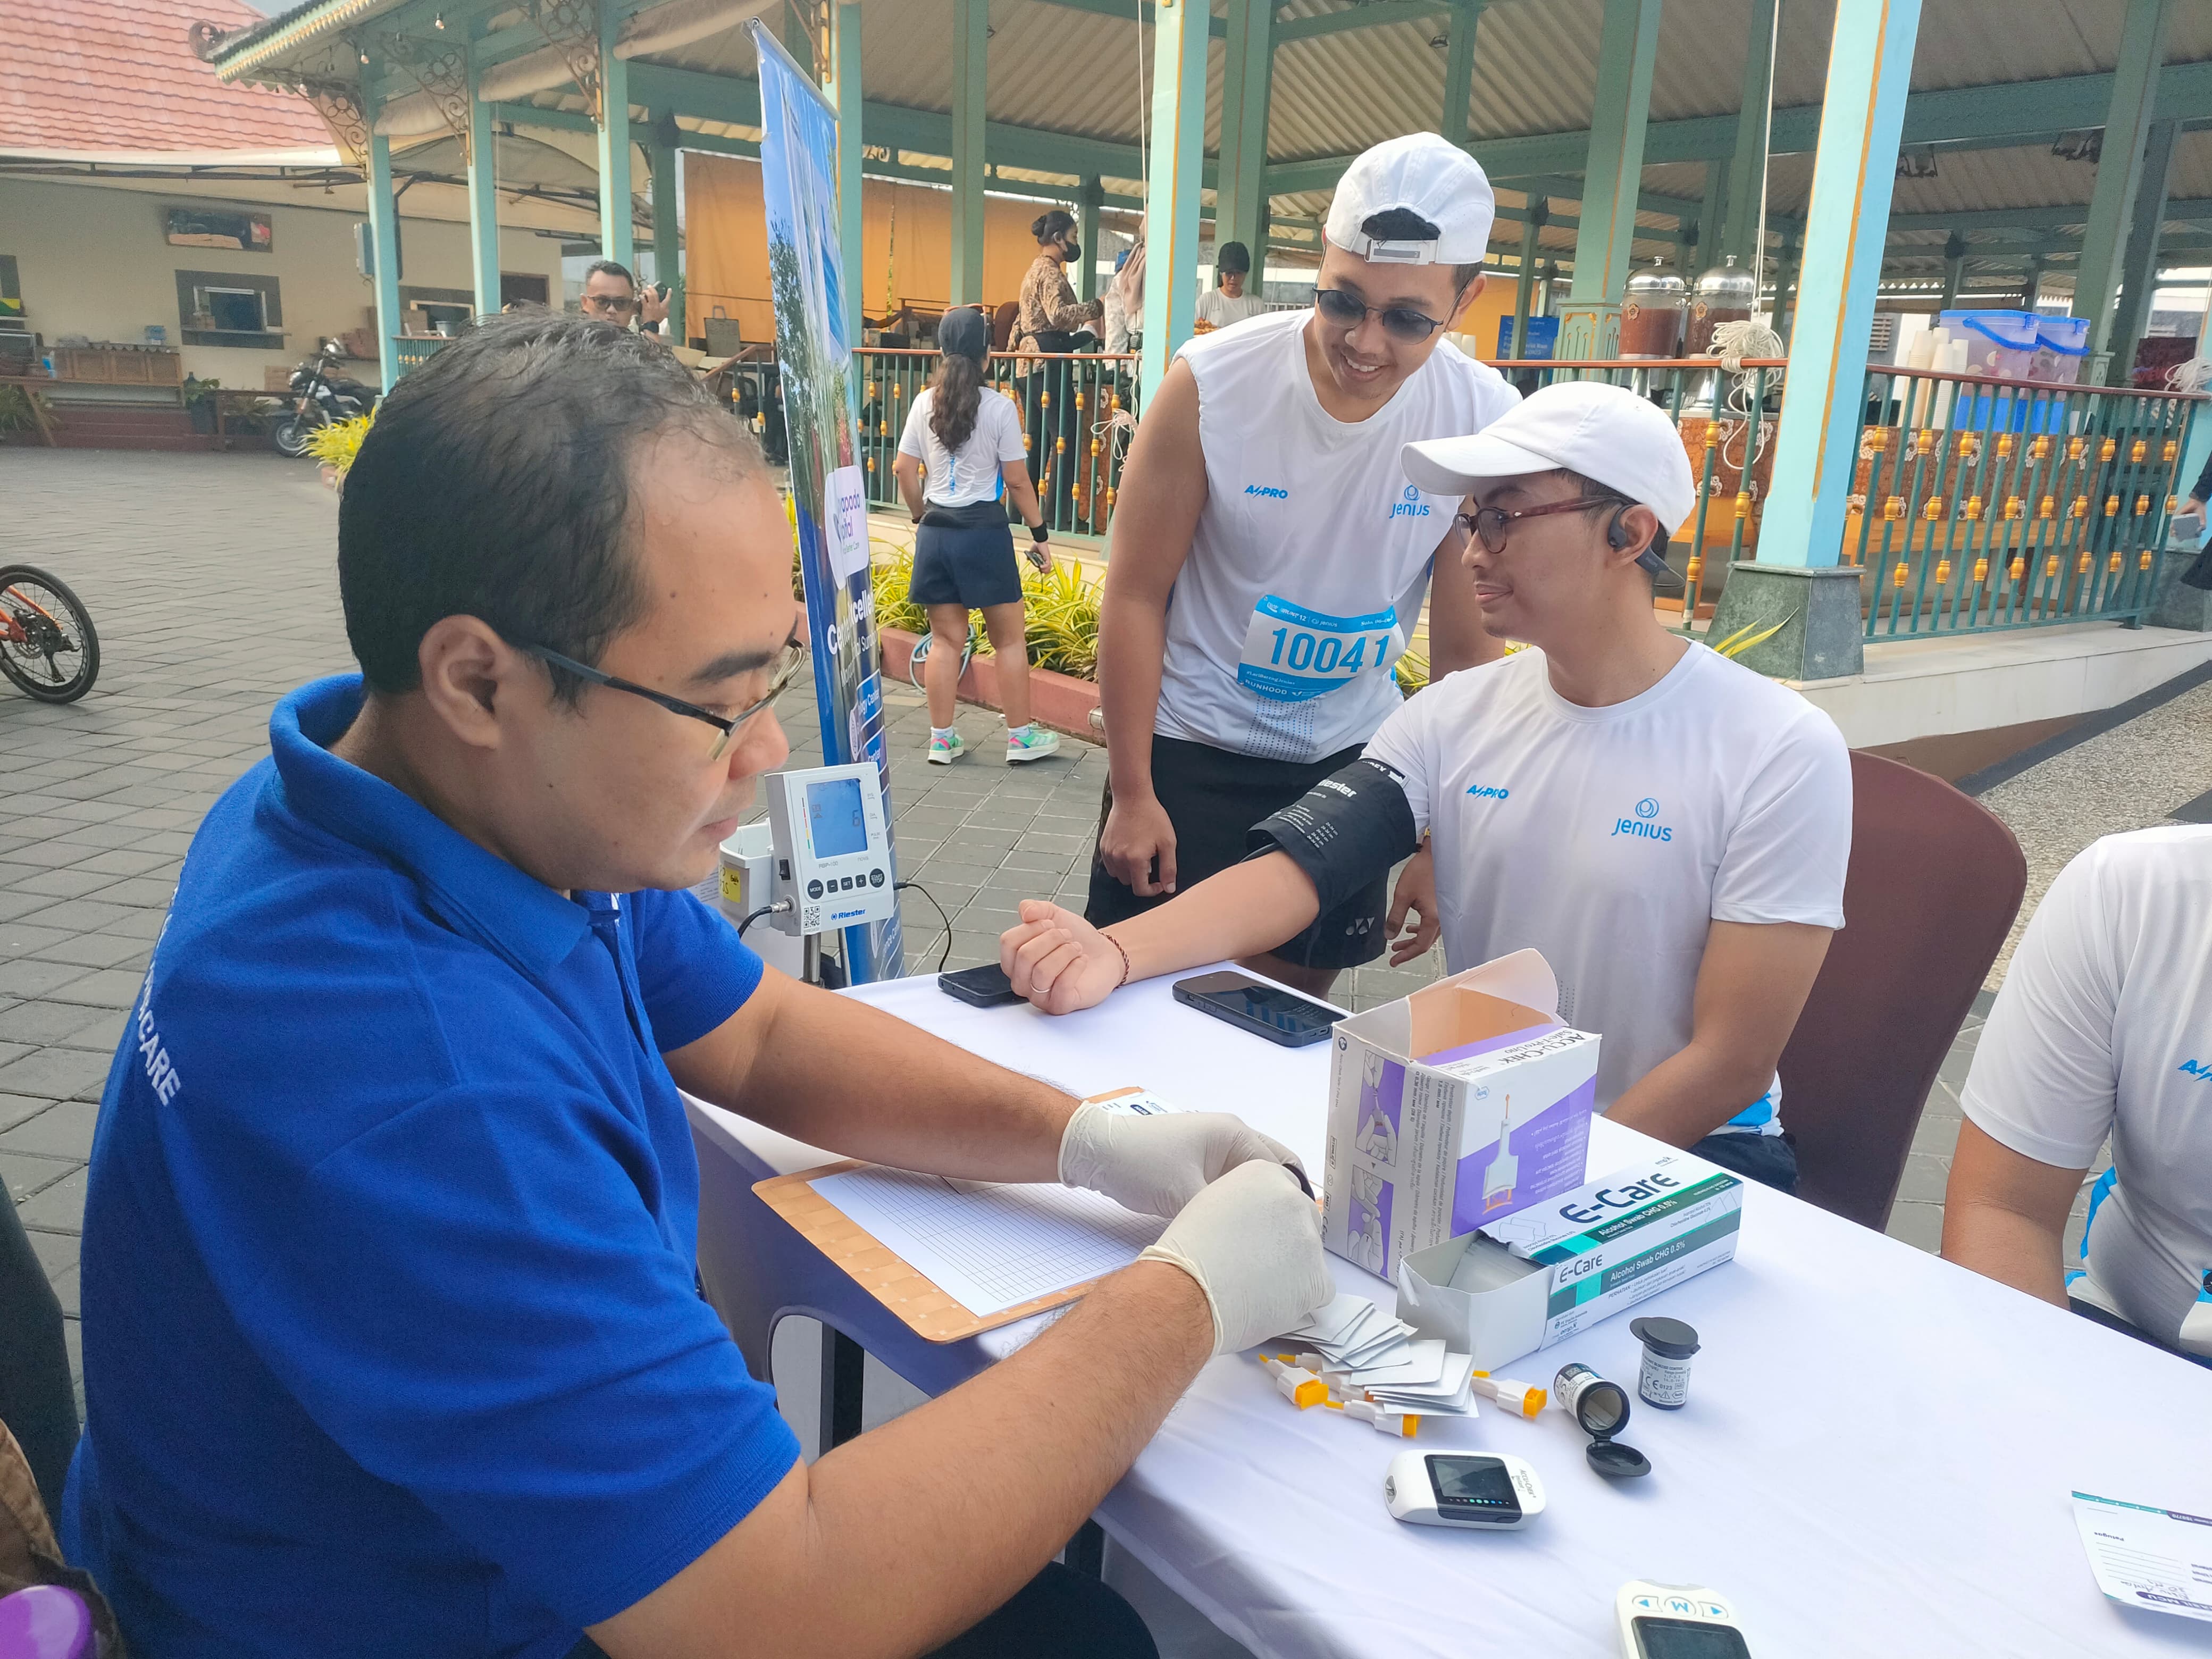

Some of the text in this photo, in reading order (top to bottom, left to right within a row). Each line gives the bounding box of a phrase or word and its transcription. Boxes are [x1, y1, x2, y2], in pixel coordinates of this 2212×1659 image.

[839, 489, 860, 516] apada
[827, 615, 851, 655] Cente
[1271, 627, 1390, 673] 10041
[839, 909, 866, 919] Riester
[1497, 1033, 1586, 1064] ACCU-CHEK
[1504, 1044, 1524, 1054] Uno
[1559, 1173, 1681, 1224] E-Care
[1598, 1221, 1623, 1236] Alcohol
[1624, 1212, 1645, 1227] Swab
[1643, 1205, 1660, 1220] CHG
[1660, 1199, 1678, 1211] 0.5%
[1559, 1253, 1603, 1284] E-Care
[1610, 1263, 1635, 1282] Alcohol
[1636, 1257, 1654, 1271] Swab
[1654, 1250, 1670, 1263] CHG
[1670, 1242, 1686, 1254] 0.5%
[2094, 1531, 2125, 1541] Petugas
